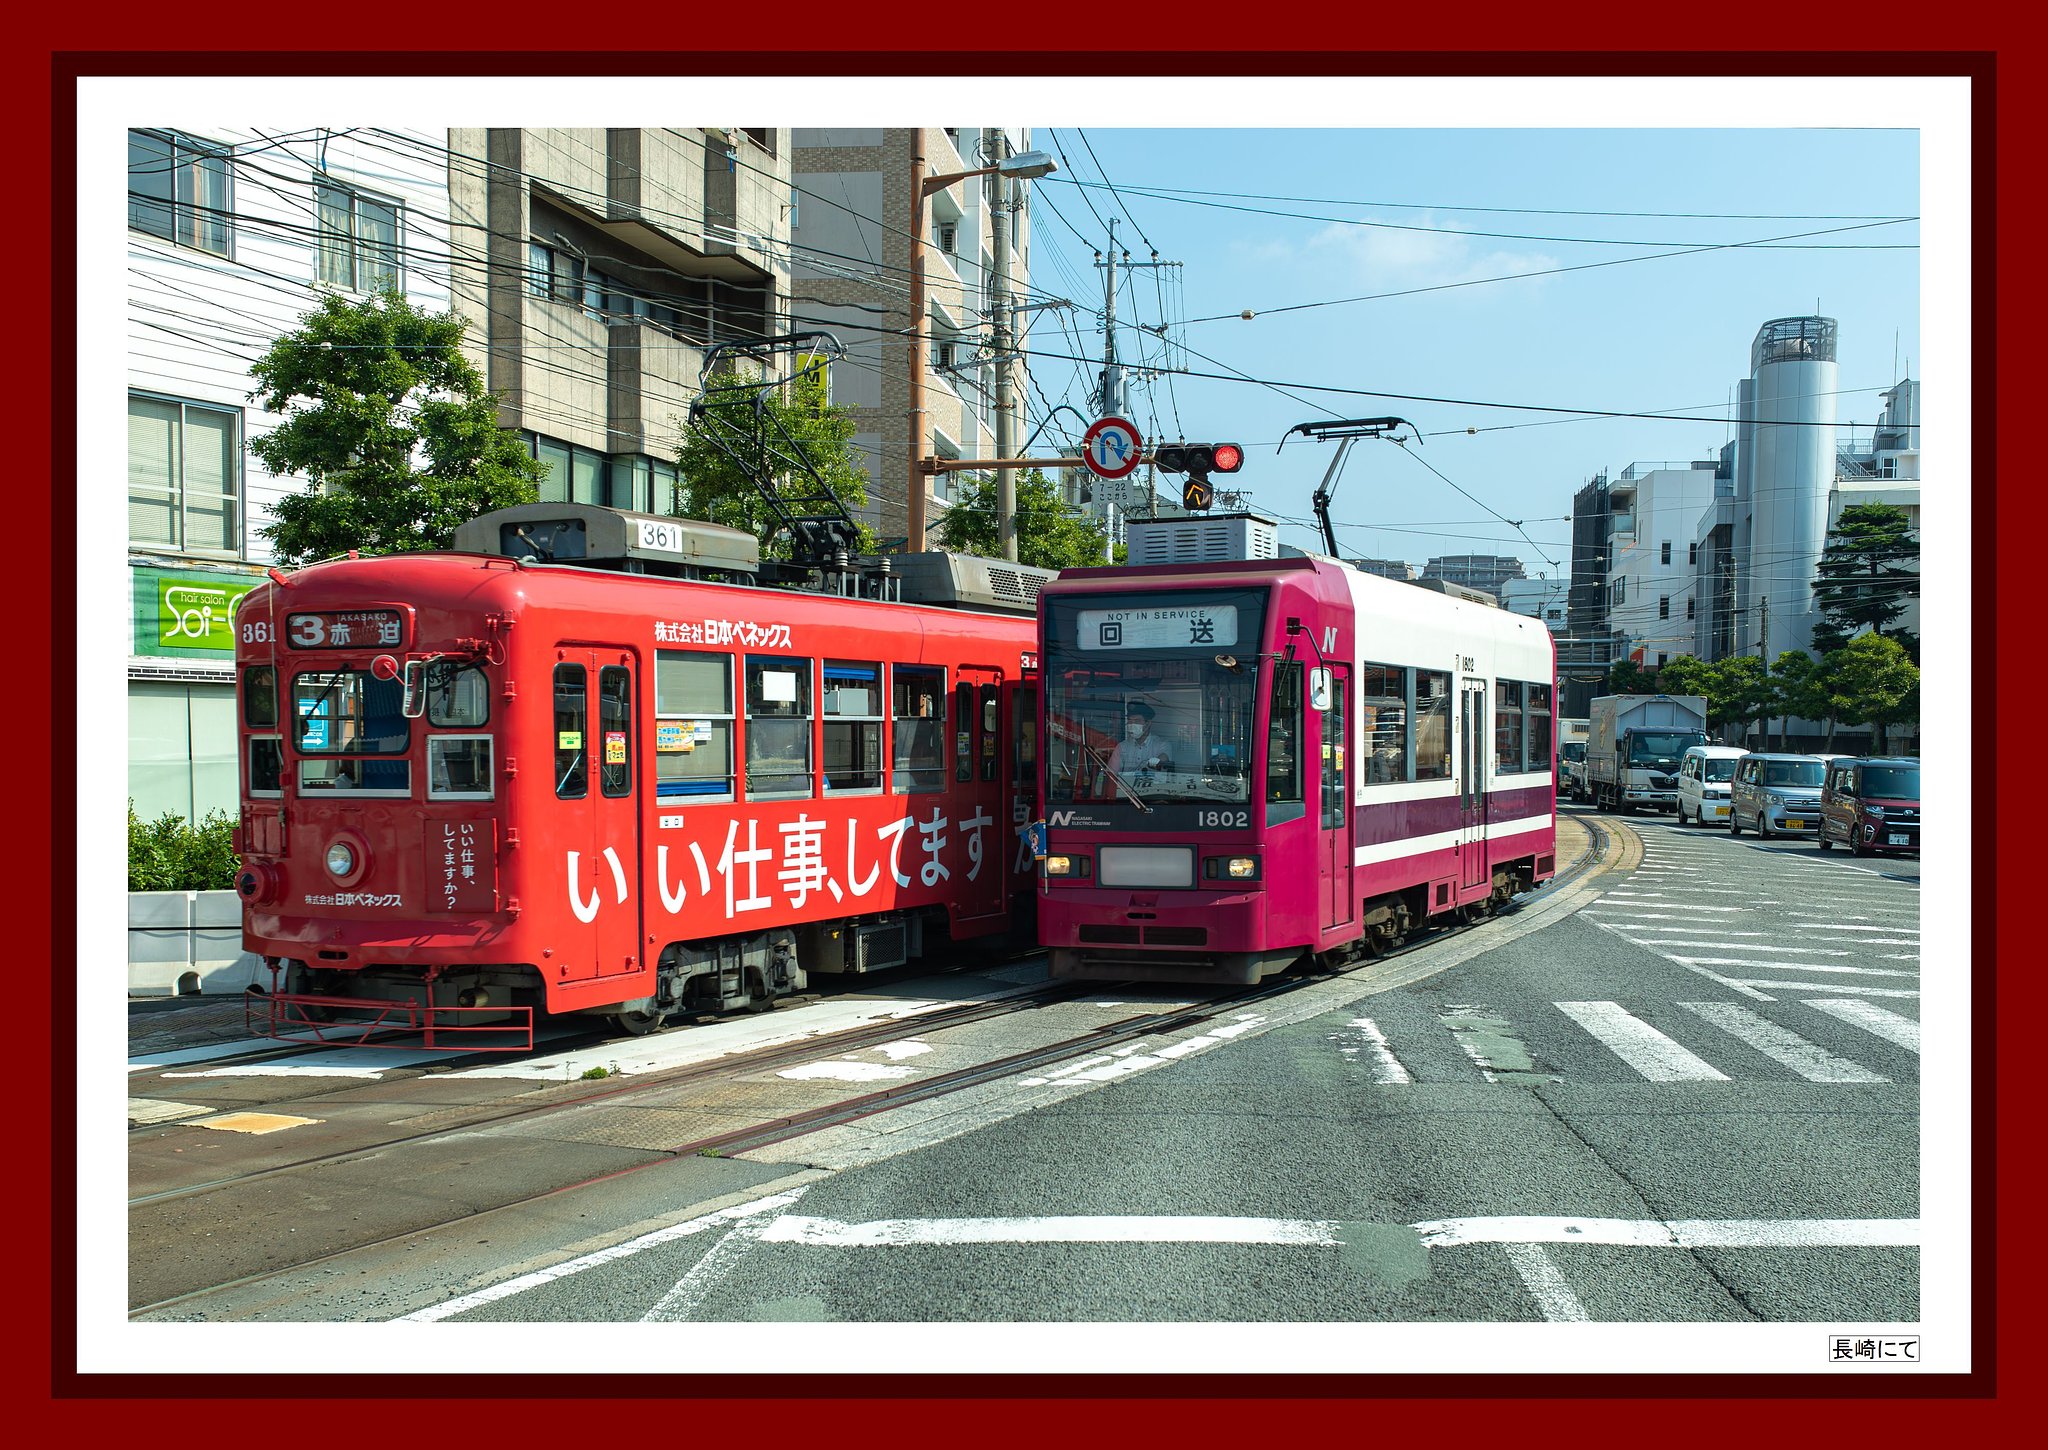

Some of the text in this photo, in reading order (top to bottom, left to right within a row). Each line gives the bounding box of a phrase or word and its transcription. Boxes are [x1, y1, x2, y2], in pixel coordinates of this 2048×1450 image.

[644, 523, 676, 549] 361
[181, 592, 224, 605] hair salon
[1108, 610, 1205, 621] NOT IN SERVICE
[243, 622, 276, 644] 361
[292, 615, 325, 646] 3
[654, 619, 792, 649] 株式会社日本ベネックス
[1100, 618, 1214, 646] 回送
[1021, 656, 1029, 668] 3
[1199, 811, 1248, 827] 1802
[461, 824, 475, 885] いい仕事、
[304, 893, 402, 907] 株式会社日本ベネックス
